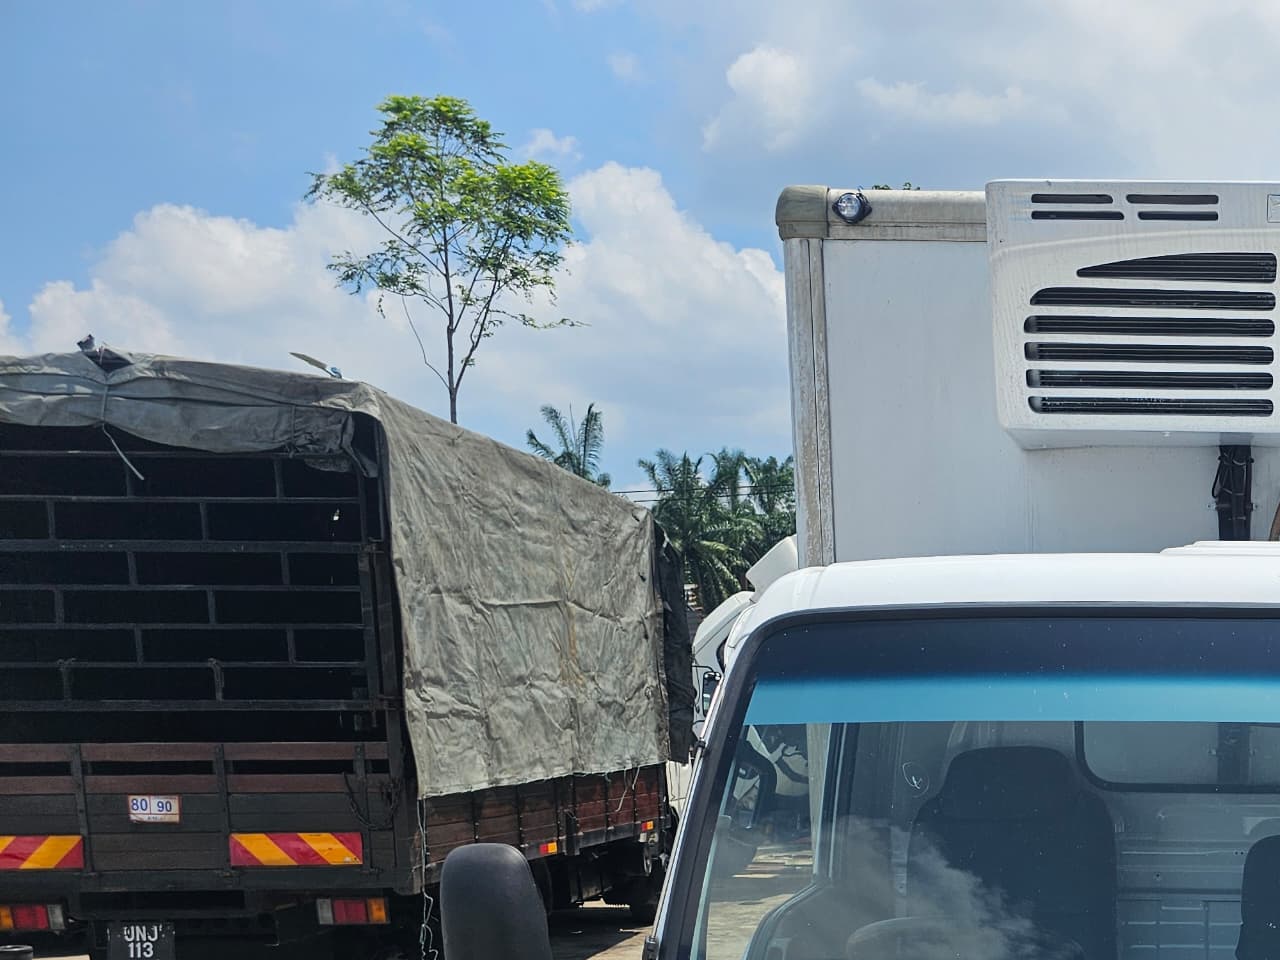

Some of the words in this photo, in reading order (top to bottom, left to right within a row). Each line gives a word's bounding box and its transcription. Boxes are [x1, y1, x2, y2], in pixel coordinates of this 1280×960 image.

[131, 798, 148, 811] 80
[156, 800, 172, 812] 90
[128, 942, 154, 958] 113
